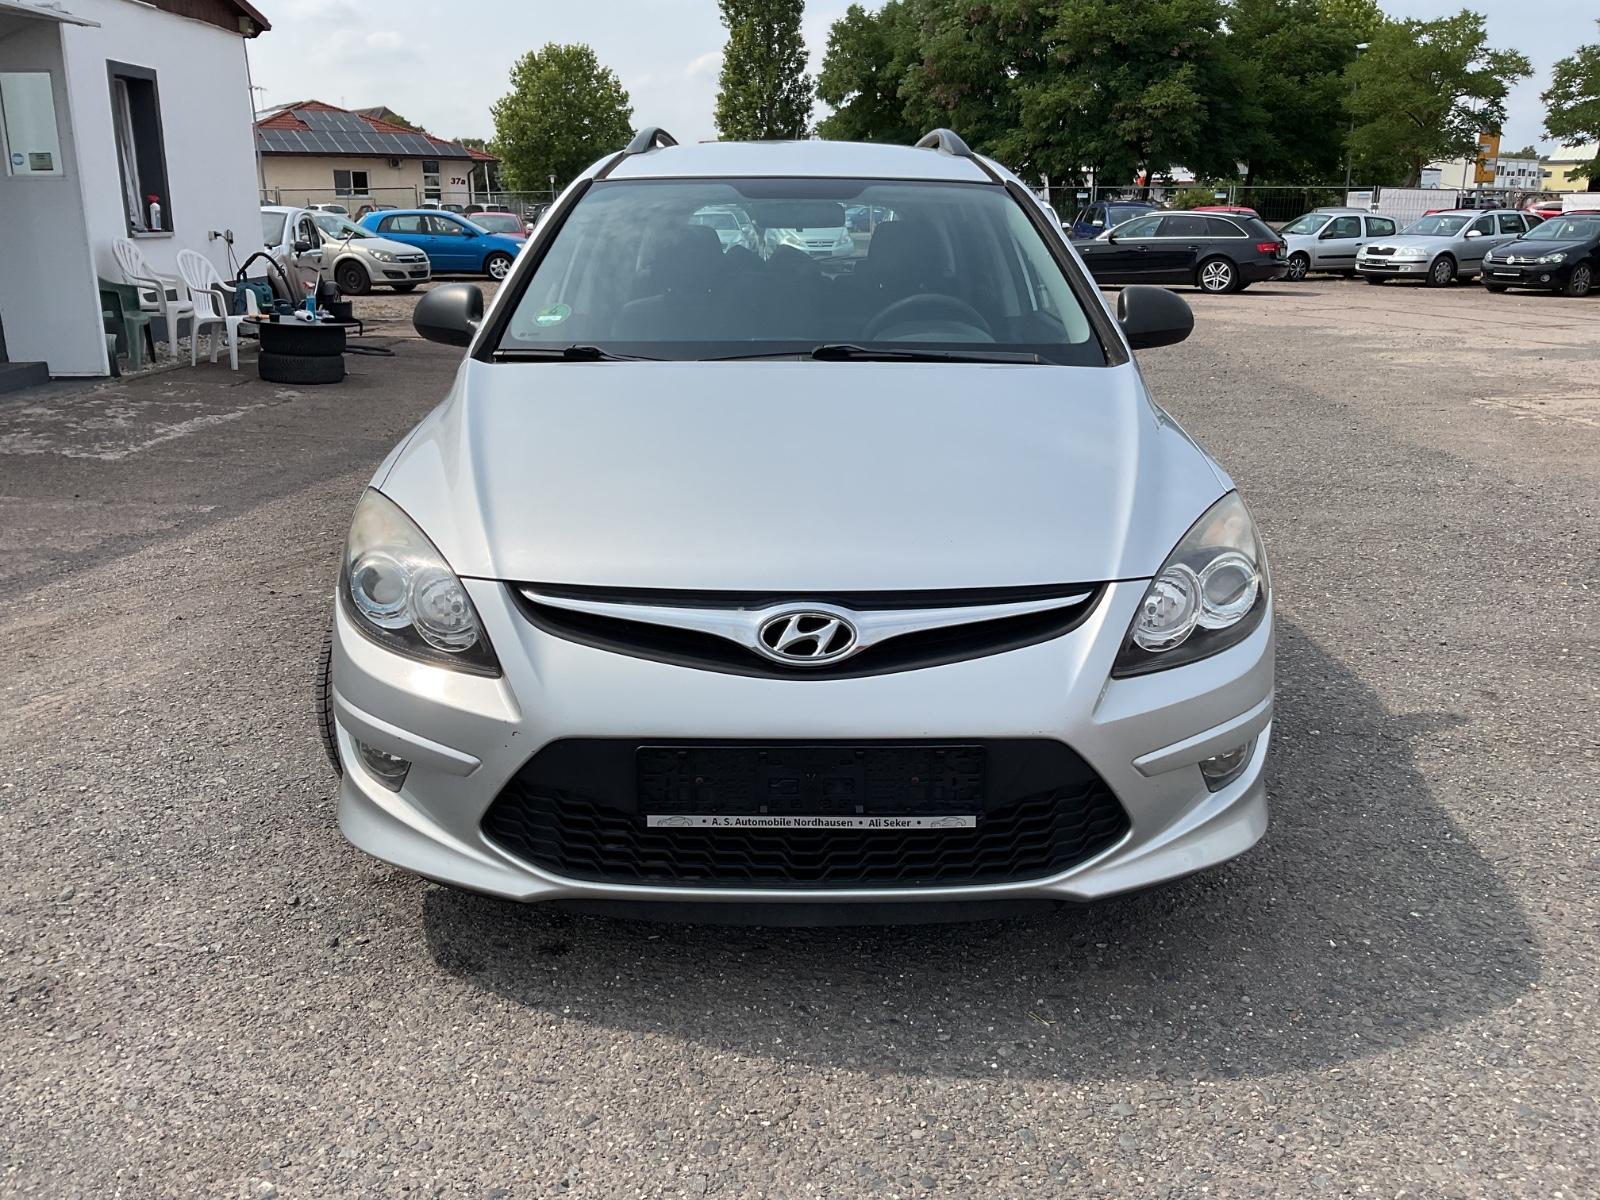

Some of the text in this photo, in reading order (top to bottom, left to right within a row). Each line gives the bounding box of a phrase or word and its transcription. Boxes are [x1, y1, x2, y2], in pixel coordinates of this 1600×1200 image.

[450, 177, 466, 185] 37a
[711, 817, 912, 827] A. S. Automobile Nordhausen Ali Seker
